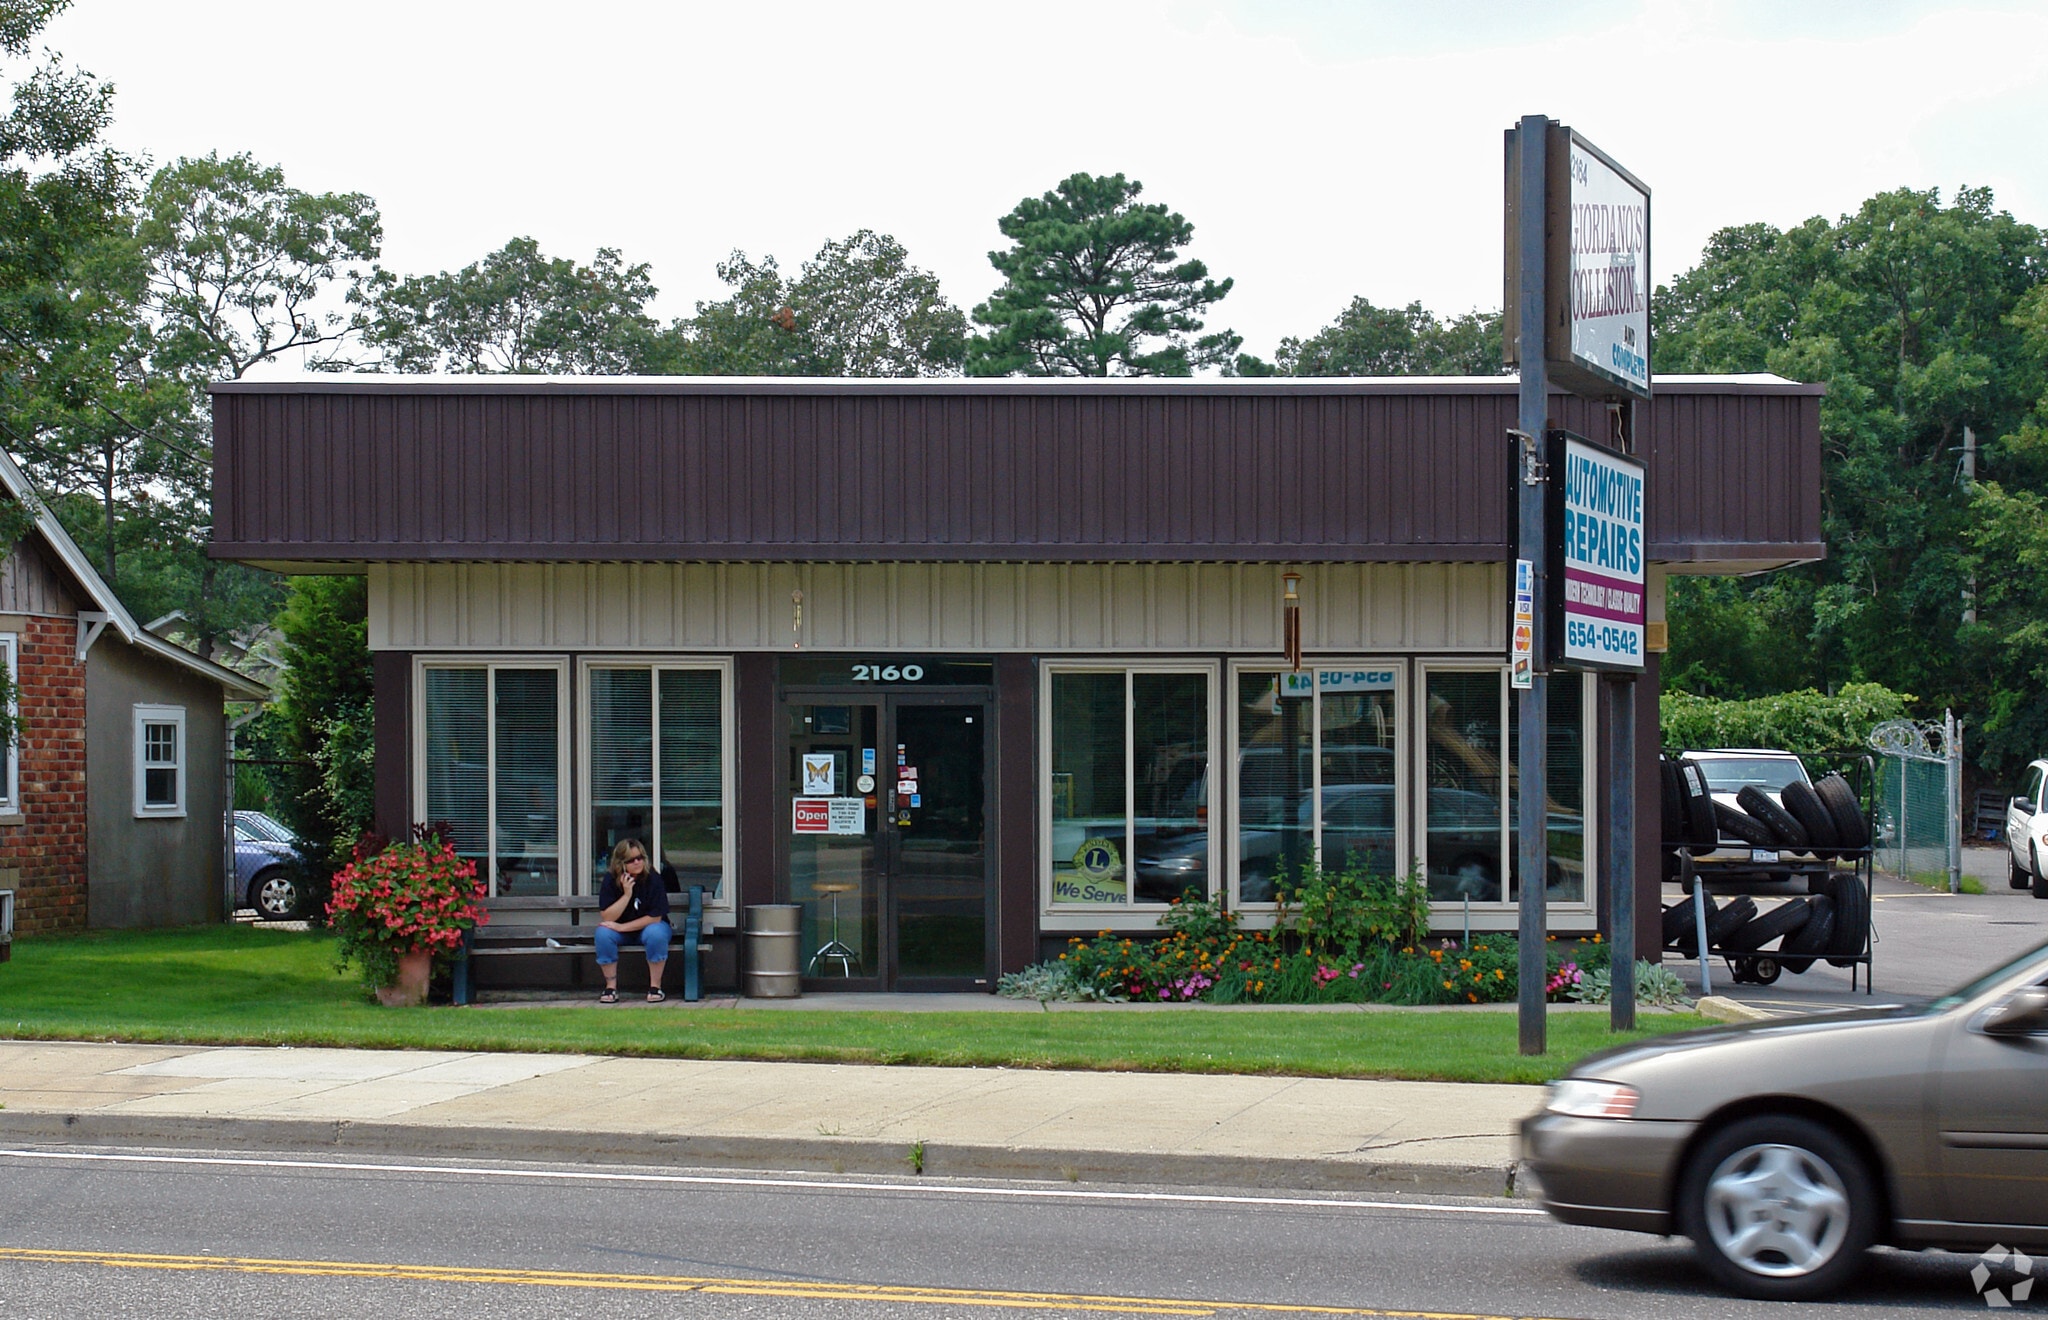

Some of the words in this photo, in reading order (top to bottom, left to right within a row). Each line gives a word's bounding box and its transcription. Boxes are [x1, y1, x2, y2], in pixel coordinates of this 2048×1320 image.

[1571, 203, 1643, 254] GIORDANO'S
[1572, 265, 1635, 321] COLLISION
[1612, 343, 1646, 380] COMPLETE
[1565, 453, 1641, 524] AUTOMOTIVE
[1565, 508, 1641, 575] REPAIRS
[1568, 620, 1638, 656] 654-0542
[851, 664, 924, 681] 2160
[797, 810, 828, 822] Open
[1090, 851, 1104, 869] L
[1056, 881, 1080, 898] We
[1082, 885, 1127, 903] Serve
